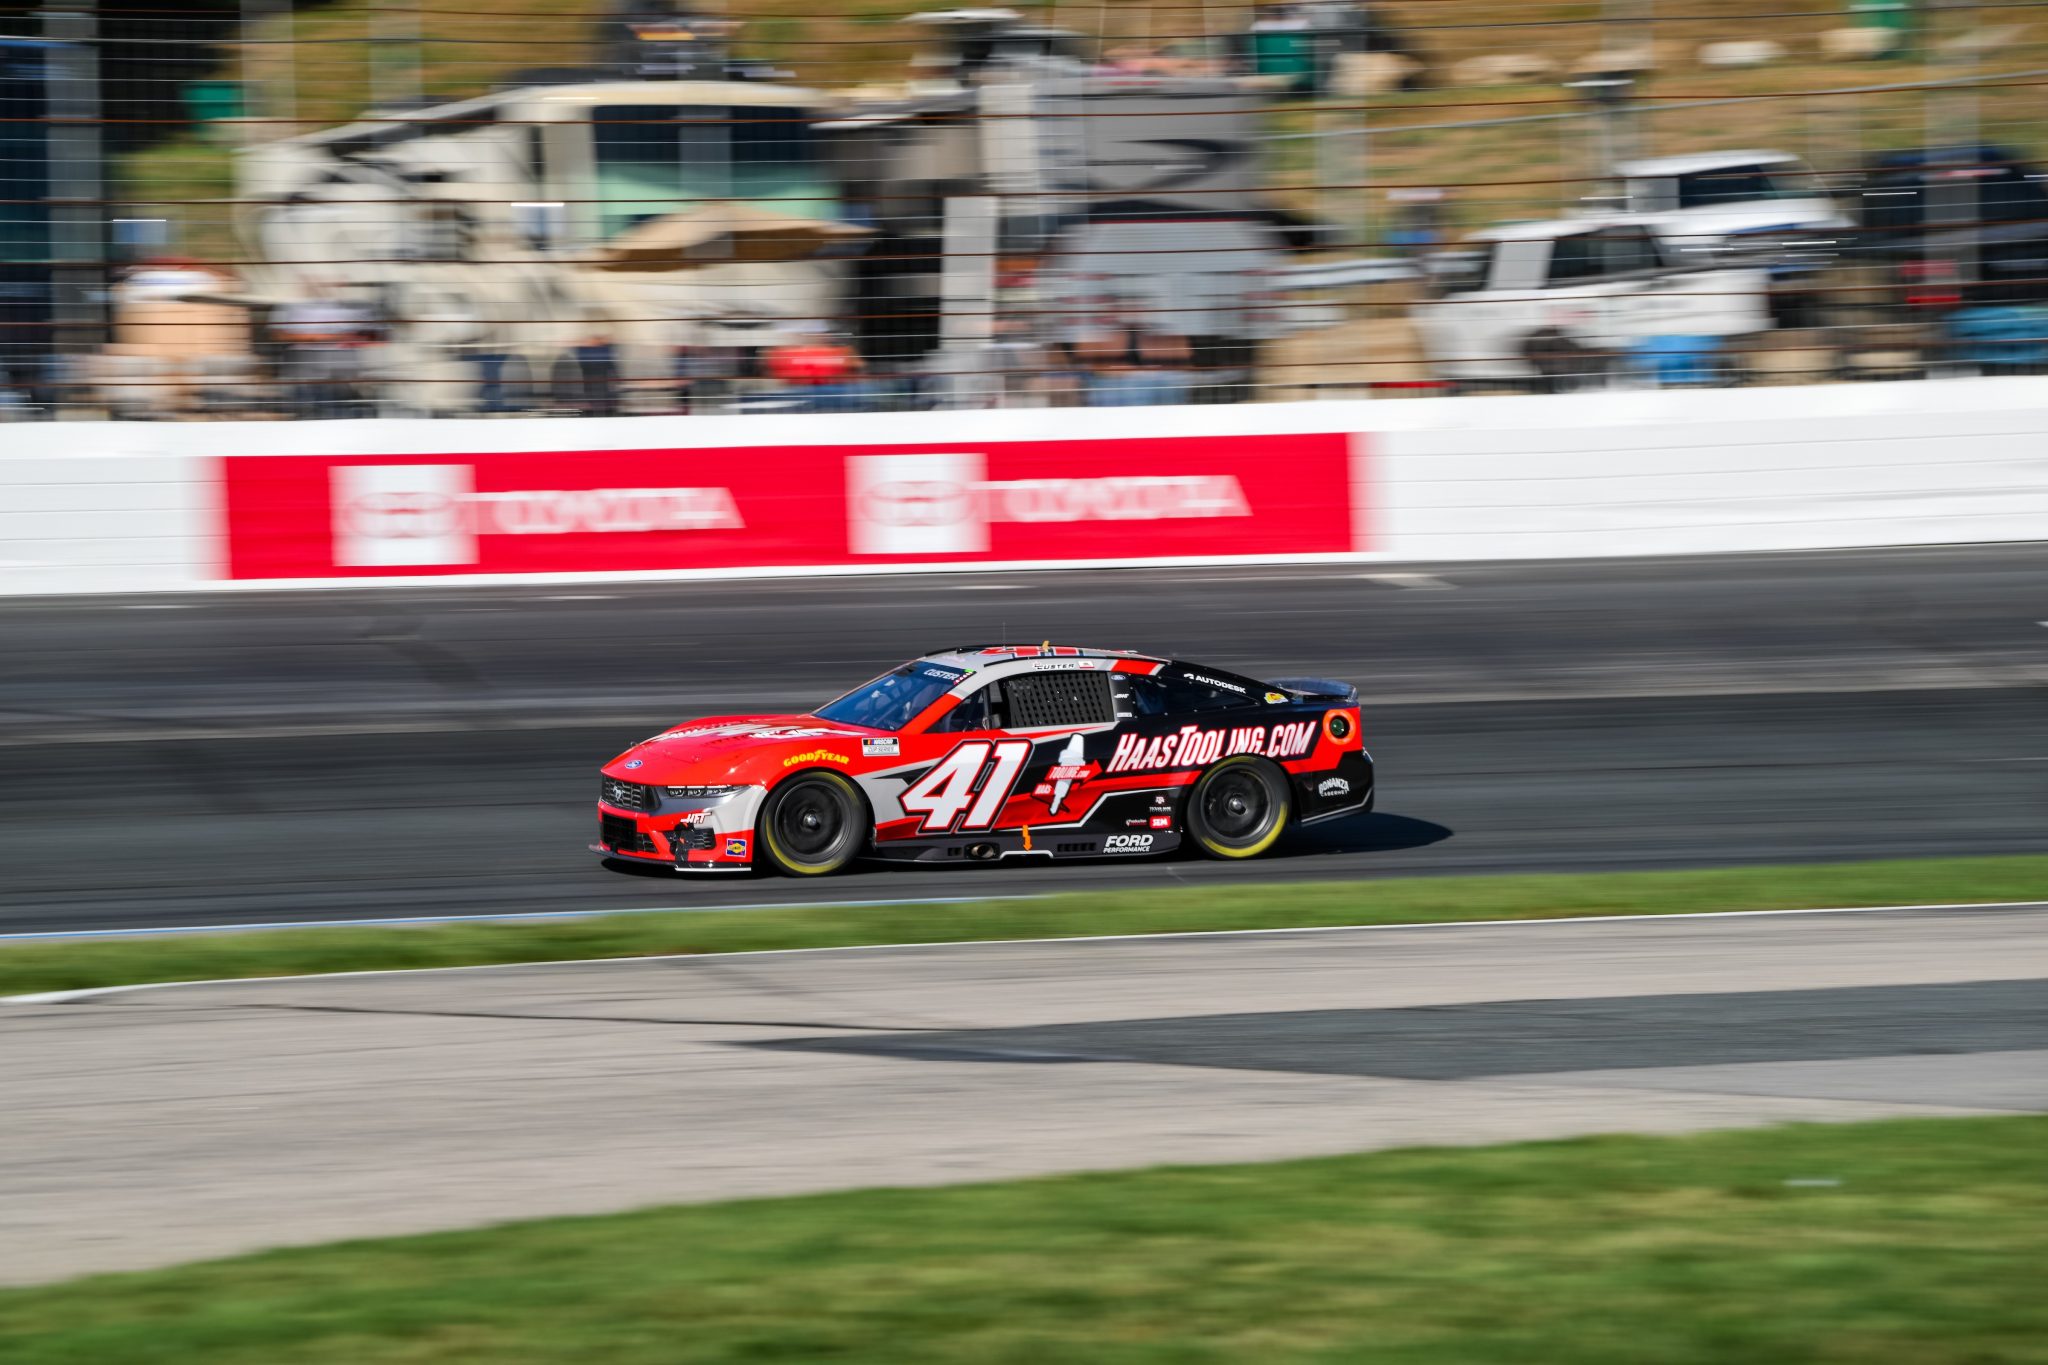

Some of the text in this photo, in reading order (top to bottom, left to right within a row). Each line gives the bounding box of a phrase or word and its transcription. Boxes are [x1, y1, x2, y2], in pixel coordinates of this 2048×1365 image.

[923, 668, 960, 681] CUSTER
[1195, 675, 1247, 694] AUTODESK
[783, 749, 850, 767] GOODYEAR
[898, 740, 1032, 832] 41
[1318, 777, 1350, 795] BONANZA
[1103, 845, 1151, 854] PERFORMANCE
[1105, 834, 1154, 847] FORD
